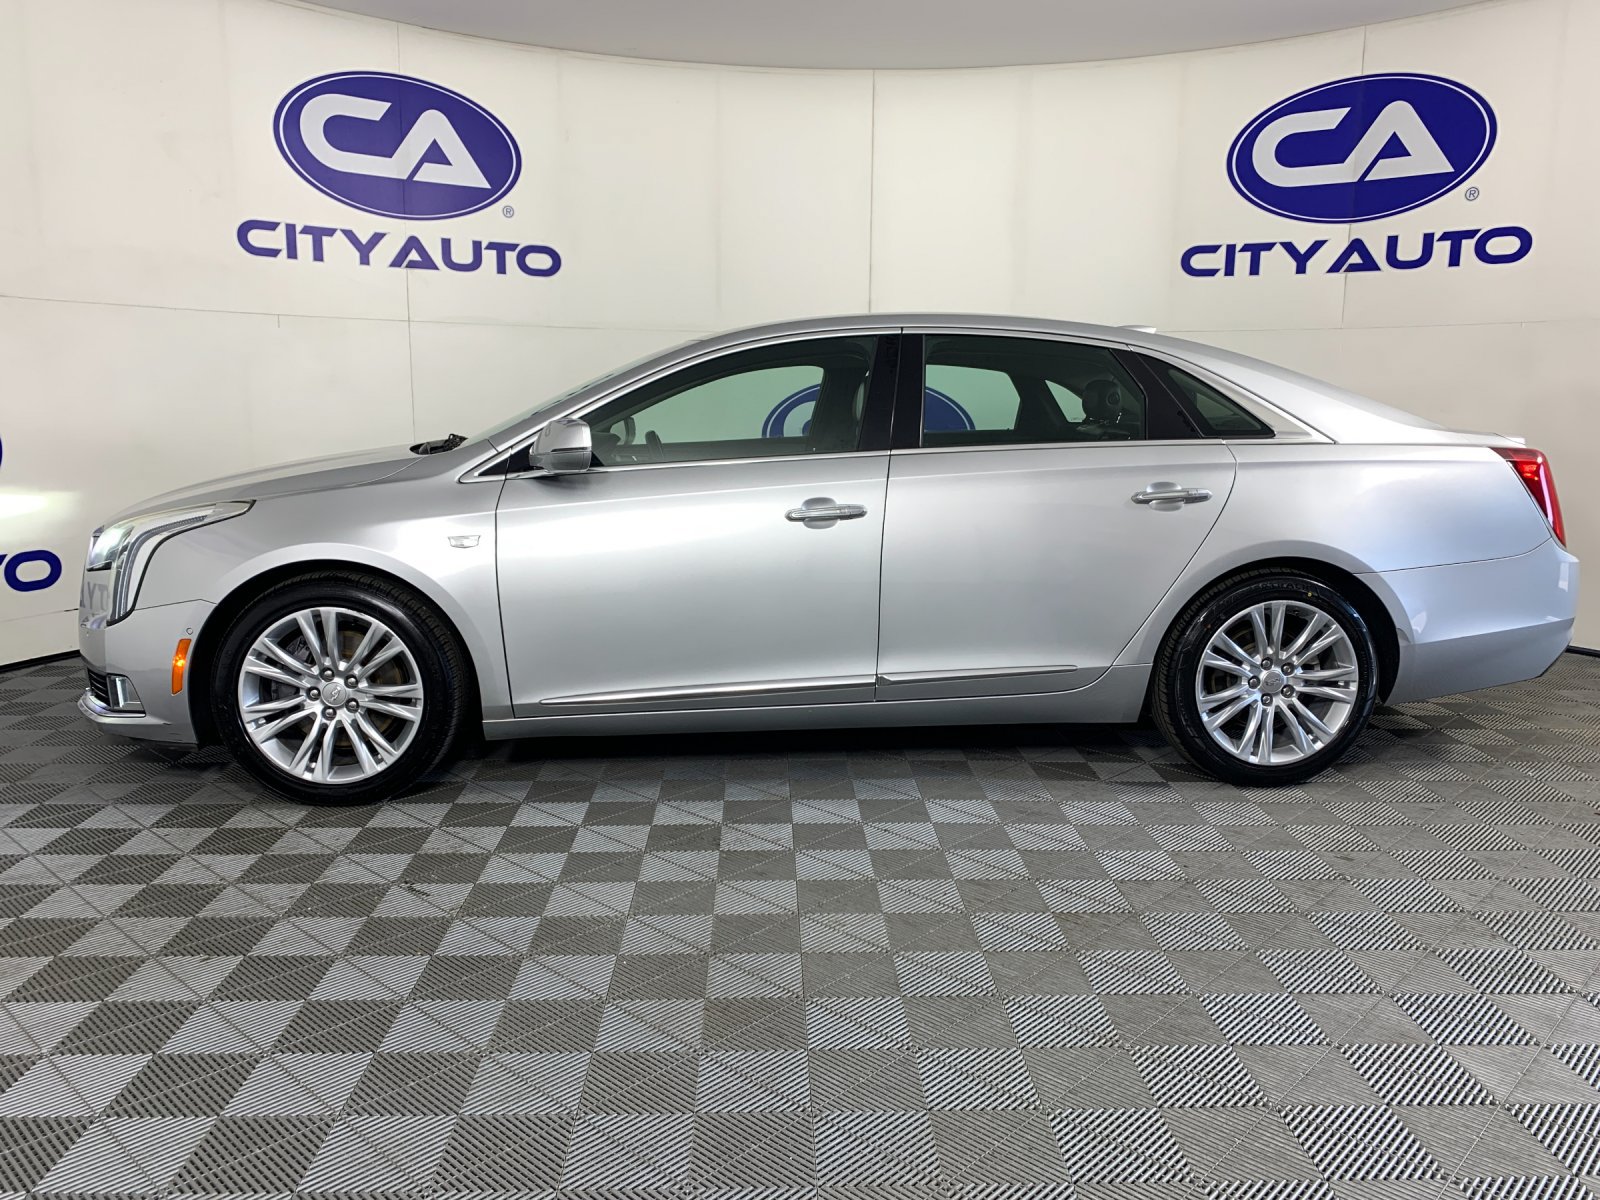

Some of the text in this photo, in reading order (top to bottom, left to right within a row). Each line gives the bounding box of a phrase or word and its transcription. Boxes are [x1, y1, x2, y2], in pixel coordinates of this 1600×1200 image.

[300, 93, 492, 188] CA
[1251, 100, 1455, 187] CA
[236, 219, 561, 277] CITY AUTO
[1180, 226, 1533, 277] CITY AUTO
[0, 550, 62, 592] O
